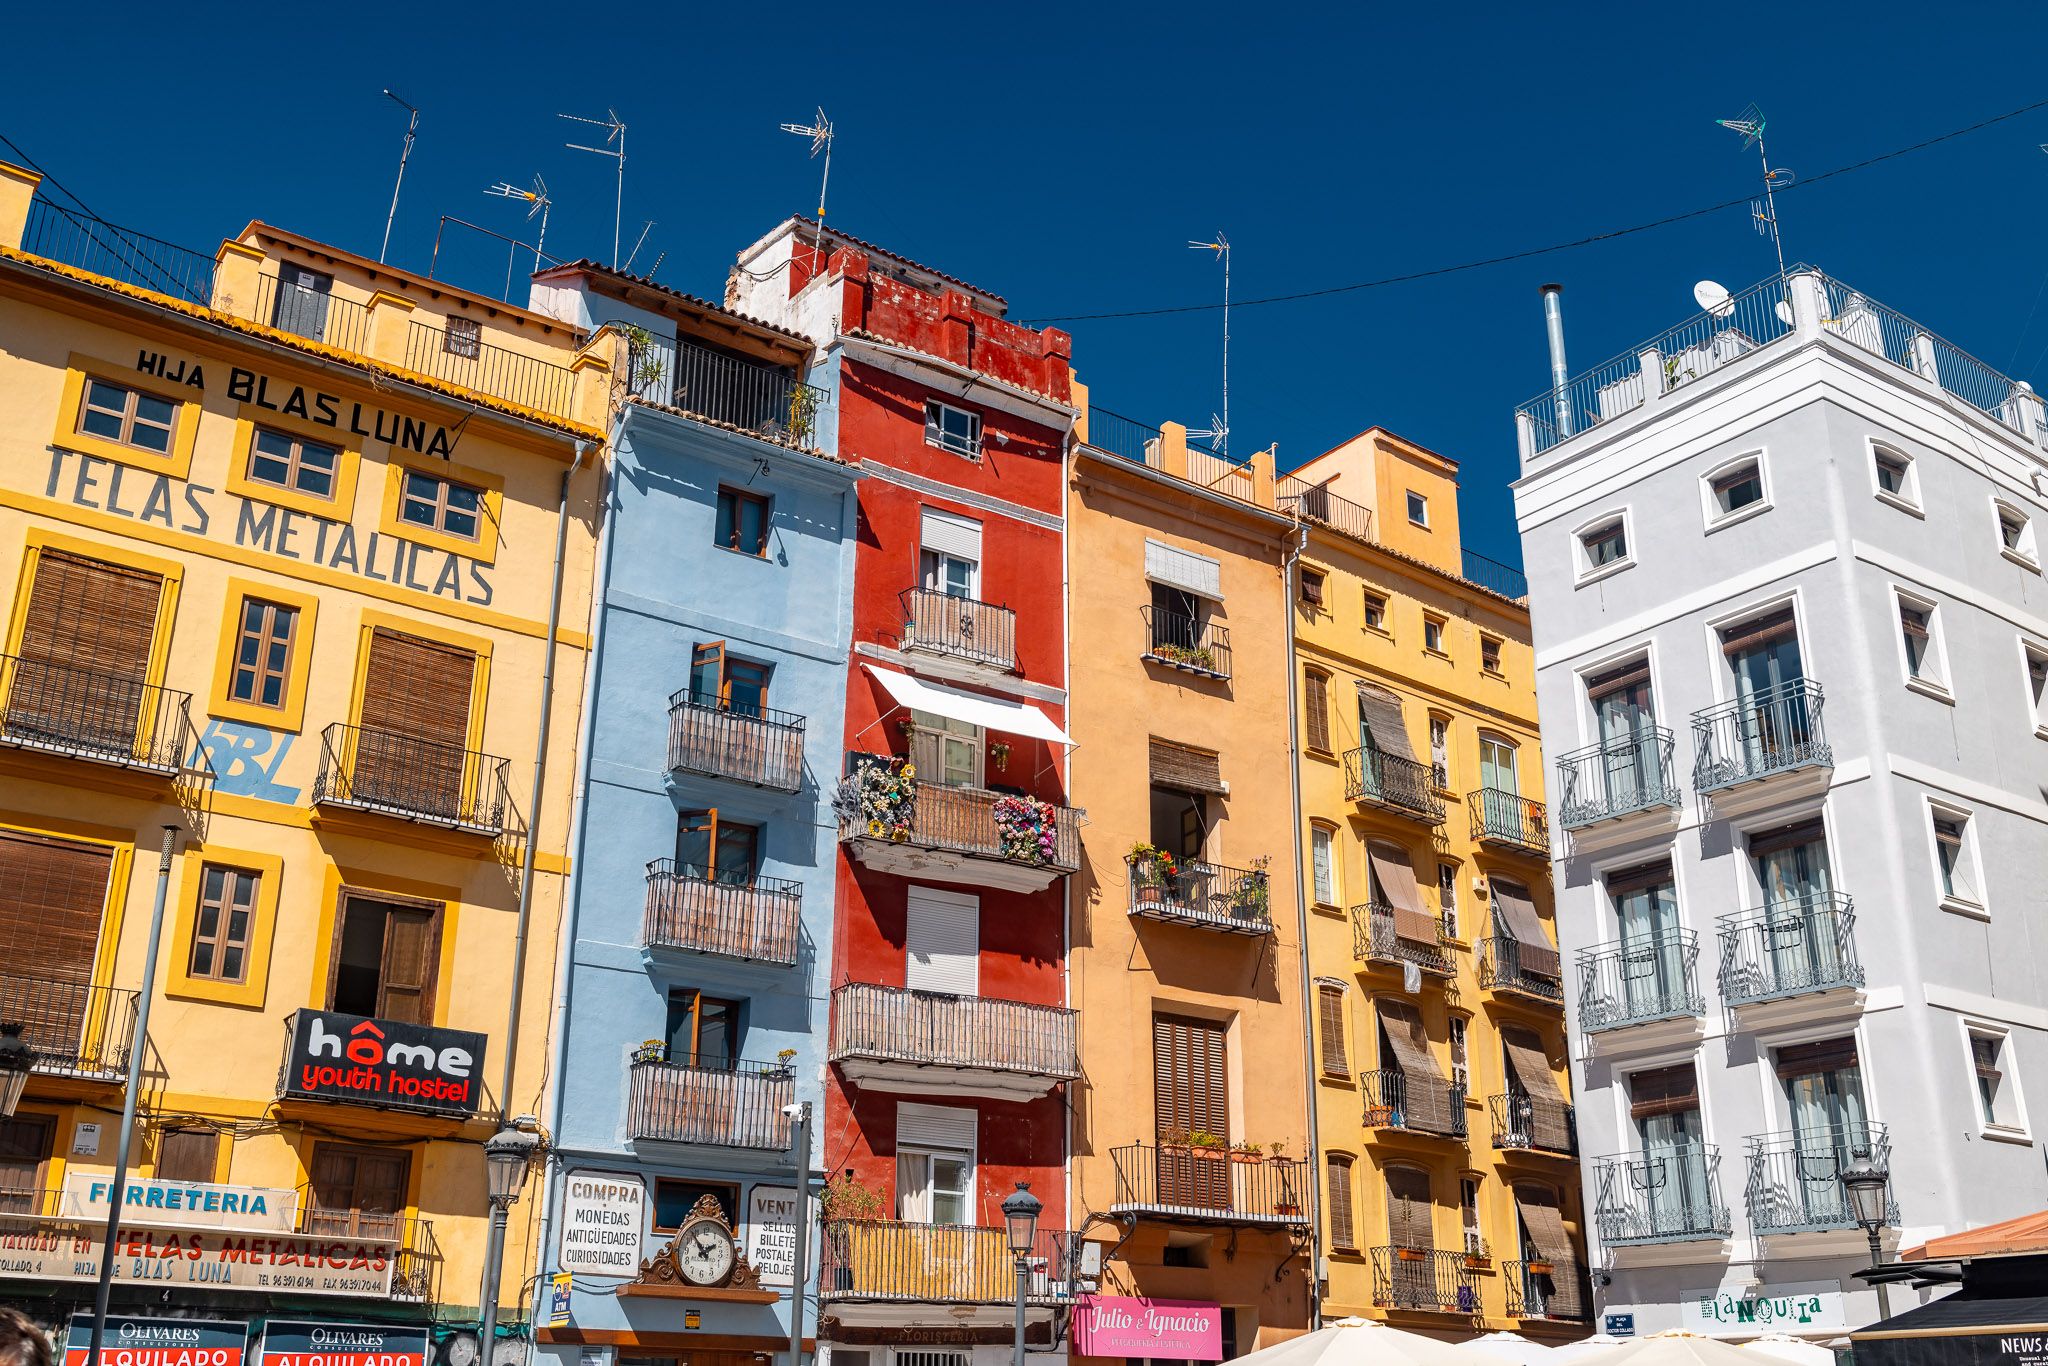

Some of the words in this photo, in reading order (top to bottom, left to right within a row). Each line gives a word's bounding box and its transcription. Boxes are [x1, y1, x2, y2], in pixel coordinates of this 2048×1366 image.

[137, 349, 205, 390] HIJA
[227, 367, 340, 427] BLAS
[351, 402, 451, 460] LUNA
[45, 444, 215, 536] TELAS
[236, 499, 495, 606] METALICAS
[301, 1063, 382, 1091] youth
[388, 1068, 470, 1102] hostel
[572, 1182, 639, 1204] COMPRA
[757, 1199, 797, 1214] VENT
[575, 1208, 630, 1226] MONEDAS
[566, 1228, 637, 1246] ANTIGÜEDADES
[760, 1234, 796, 1249] BILLETE
[73, 1235, 91, 1255] EN
[114, 1231, 203, 1261] TELAS
[219, 1237, 387, 1272] METALICAS
[566, 1249, 631, 1266] CURIOSIDADES
[755, 1247, 796, 1263] POSTALE
[35, 1260, 42, 1273] 4
[73, 1261, 96, 1276] HIJA
[132, 1257, 174, 1280] BLAS
[188, 1261, 232, 1285] LUNA
[258, 1274, 269, 1286] TEL
[323, 1277, 337, 1290] FAX
[162, 1290, 170, 1301] 4
[555, 1302, 567, 1311] ATM
[1090, 1306, 1133, 1333] Julio
[1136, 1318, 1143, 1330] &
[1144, 1308, 1210, 1337] Ignacio
[119, 1322, 200, 1341] OLIVARES
[311, 1328, 383, 1345] OLIVARES
[118, 1340, 199, 1348] CONSULTORES
[2001, 1337, 2042, 1353] NEWS
